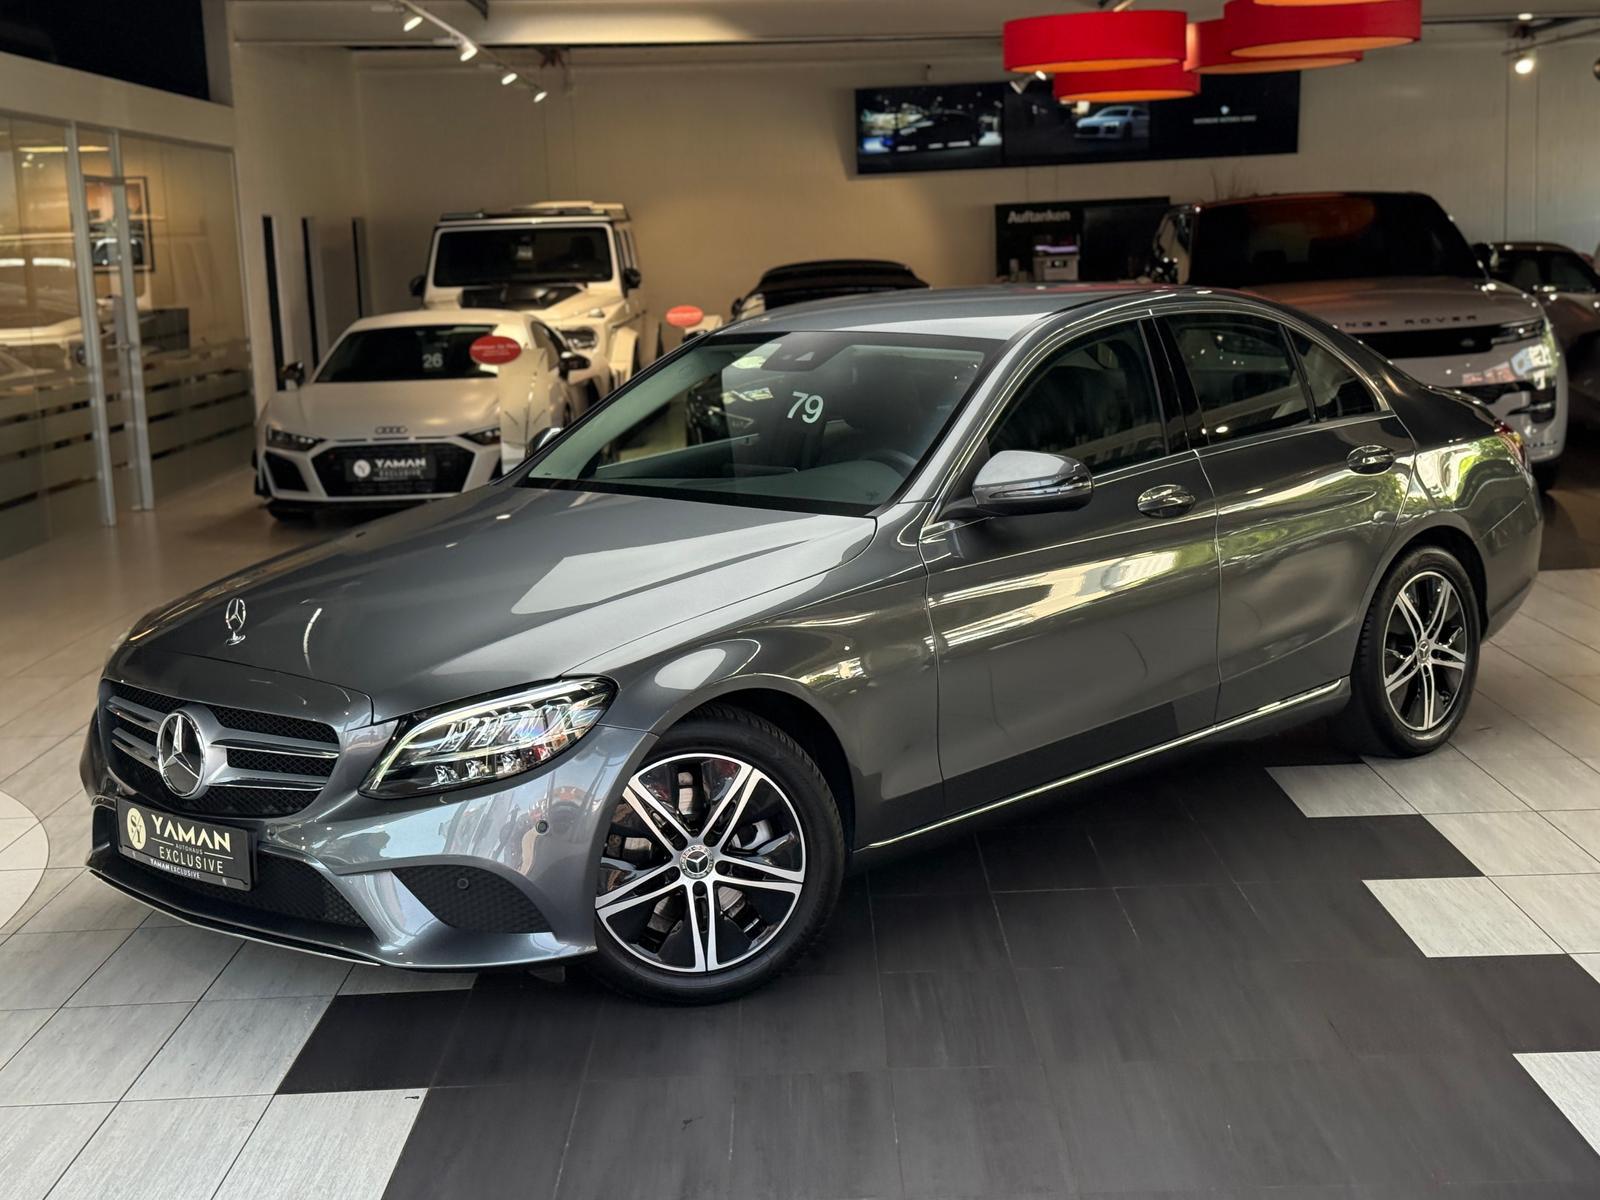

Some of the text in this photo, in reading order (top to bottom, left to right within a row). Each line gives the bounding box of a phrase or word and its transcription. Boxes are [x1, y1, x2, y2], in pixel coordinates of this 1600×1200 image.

[1344, 314, 1477, 328] NGE ROVER
[422, 353, 443, 368] 26
[786, 391, 824, 423] 79
[374, 457, 426, 468] YAMAN
[151, 814, 231, 852] YAMAN
[175, 843, 203, 854] AUTOHAUS
[150, 858, 201, 879] YAMAN EXCLUSIVE
[159, 846, 224, 874] EXCLUSIVE
